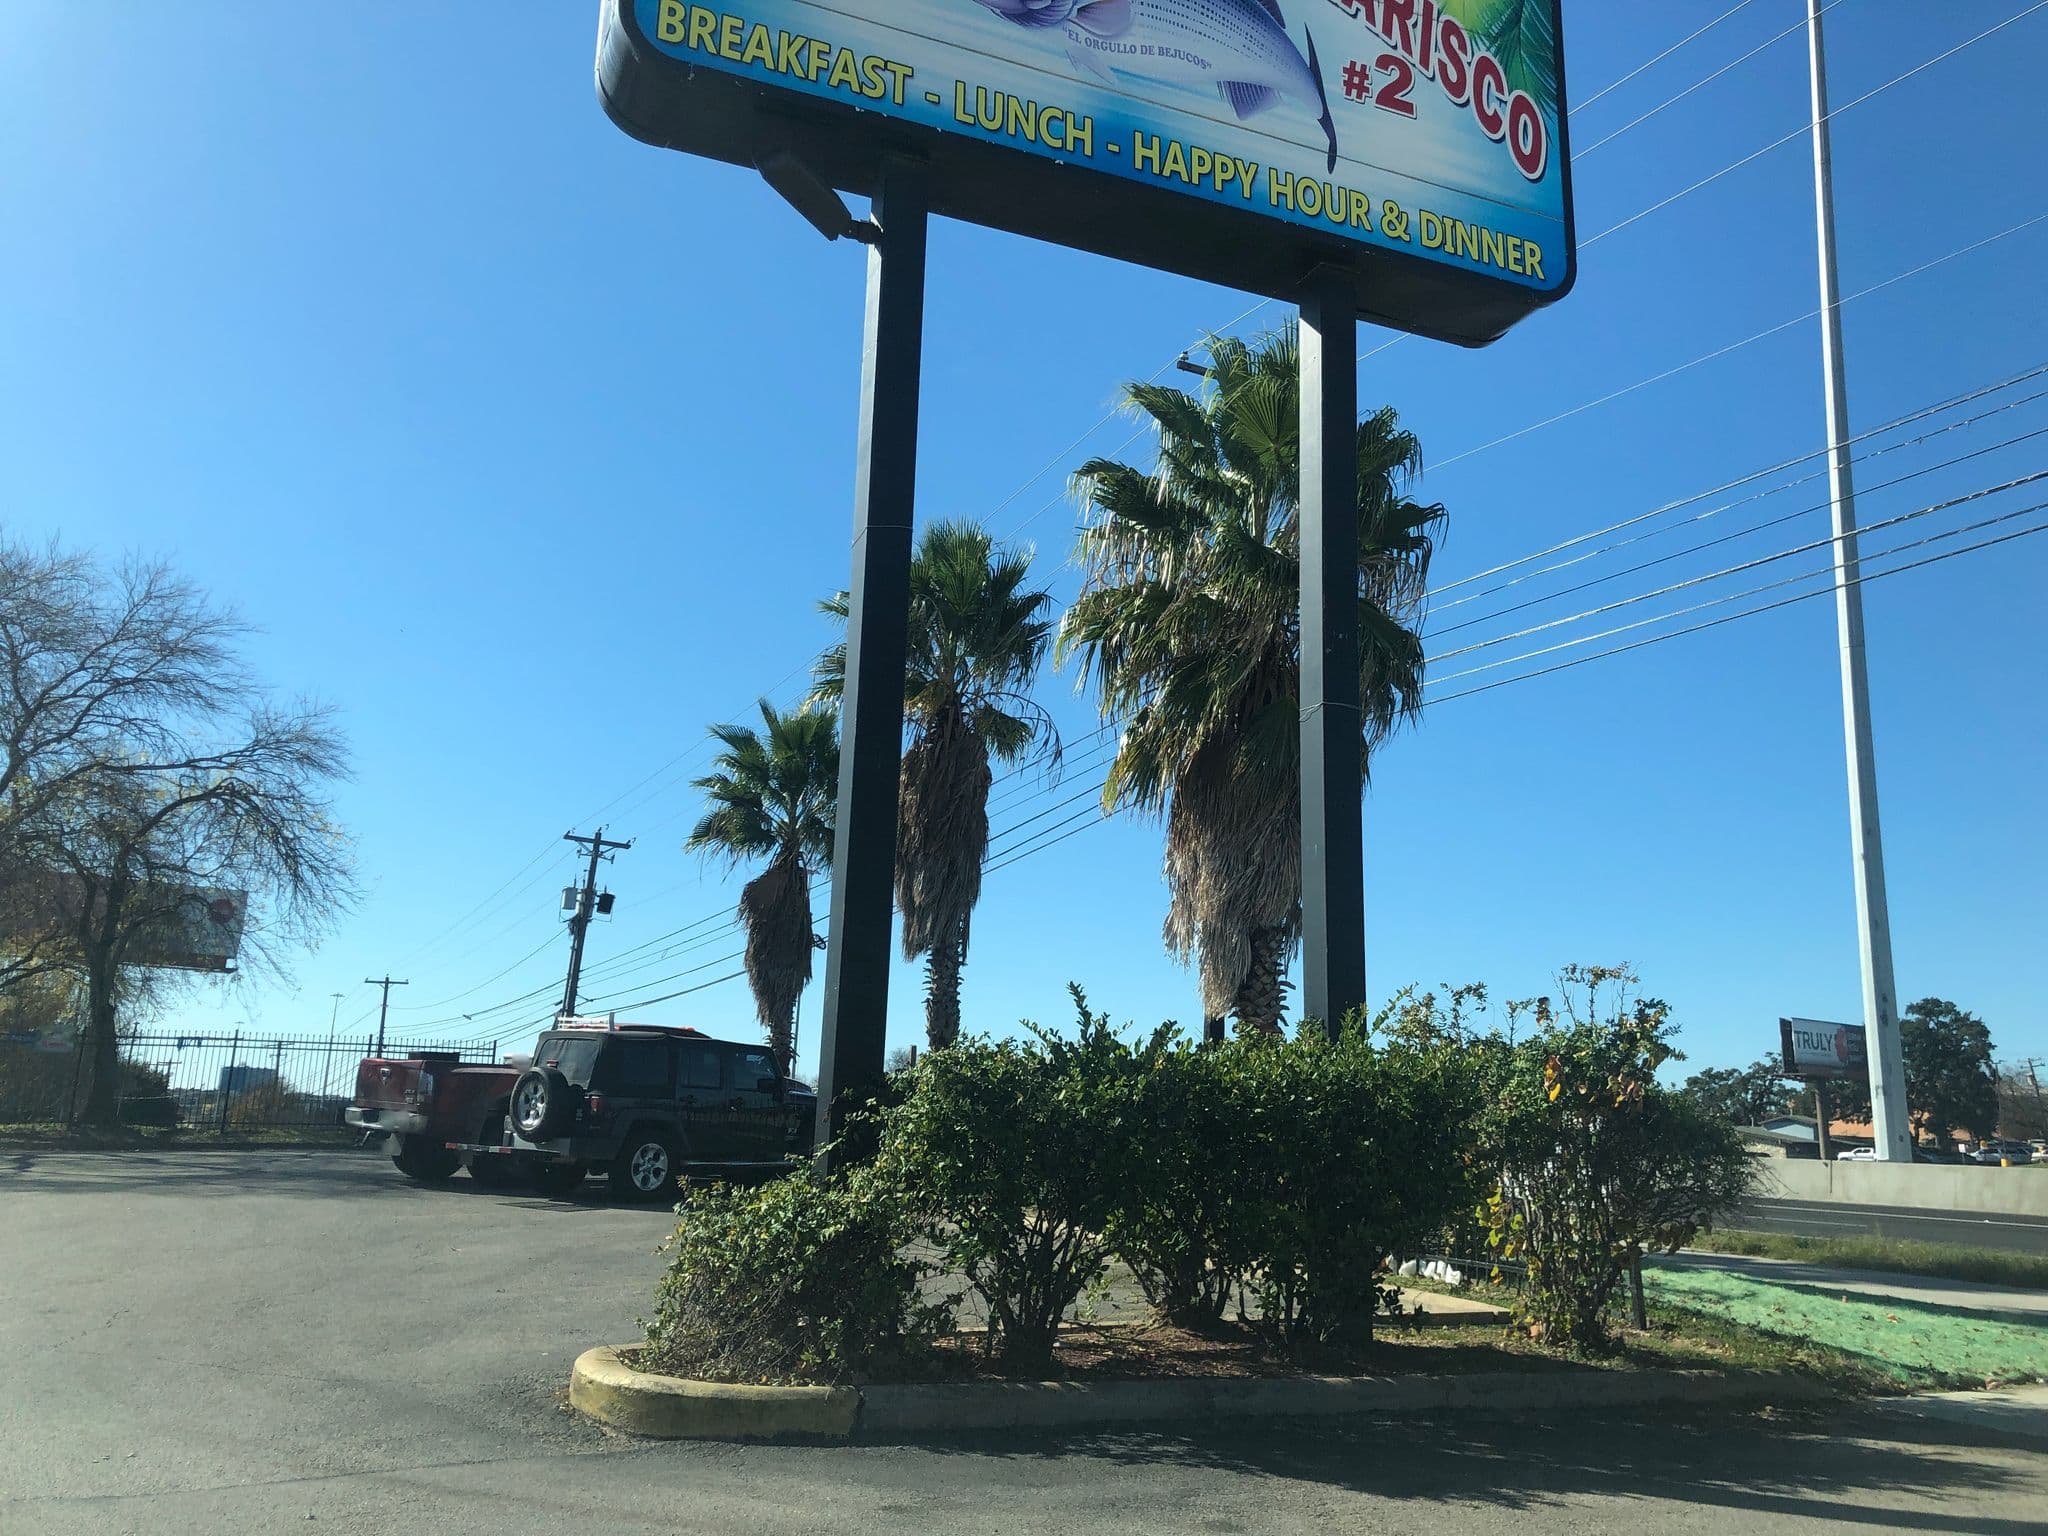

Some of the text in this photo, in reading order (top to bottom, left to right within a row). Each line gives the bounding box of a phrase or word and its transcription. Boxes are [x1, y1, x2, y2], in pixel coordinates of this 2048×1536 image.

[1084, 36, 1137, 55] ORGULLO
[1140, 44, 1155, 56] DE
[1340, 0, 1547, 180] RISCO
[1342, 54, 1417, 119] #2
[657, 0, 914, 105] BREAKFAST
[953, 80, 1094, 157] LUNCH
[1133, 130, 1259, 199] HAPPY
[1269, 168, 1372, 231] HOUR
[1381, 200, 1410, 242] &
[1418, 210, 1545, 281] DINNER
[1794, 1030, 1832, 1052] TRULY
